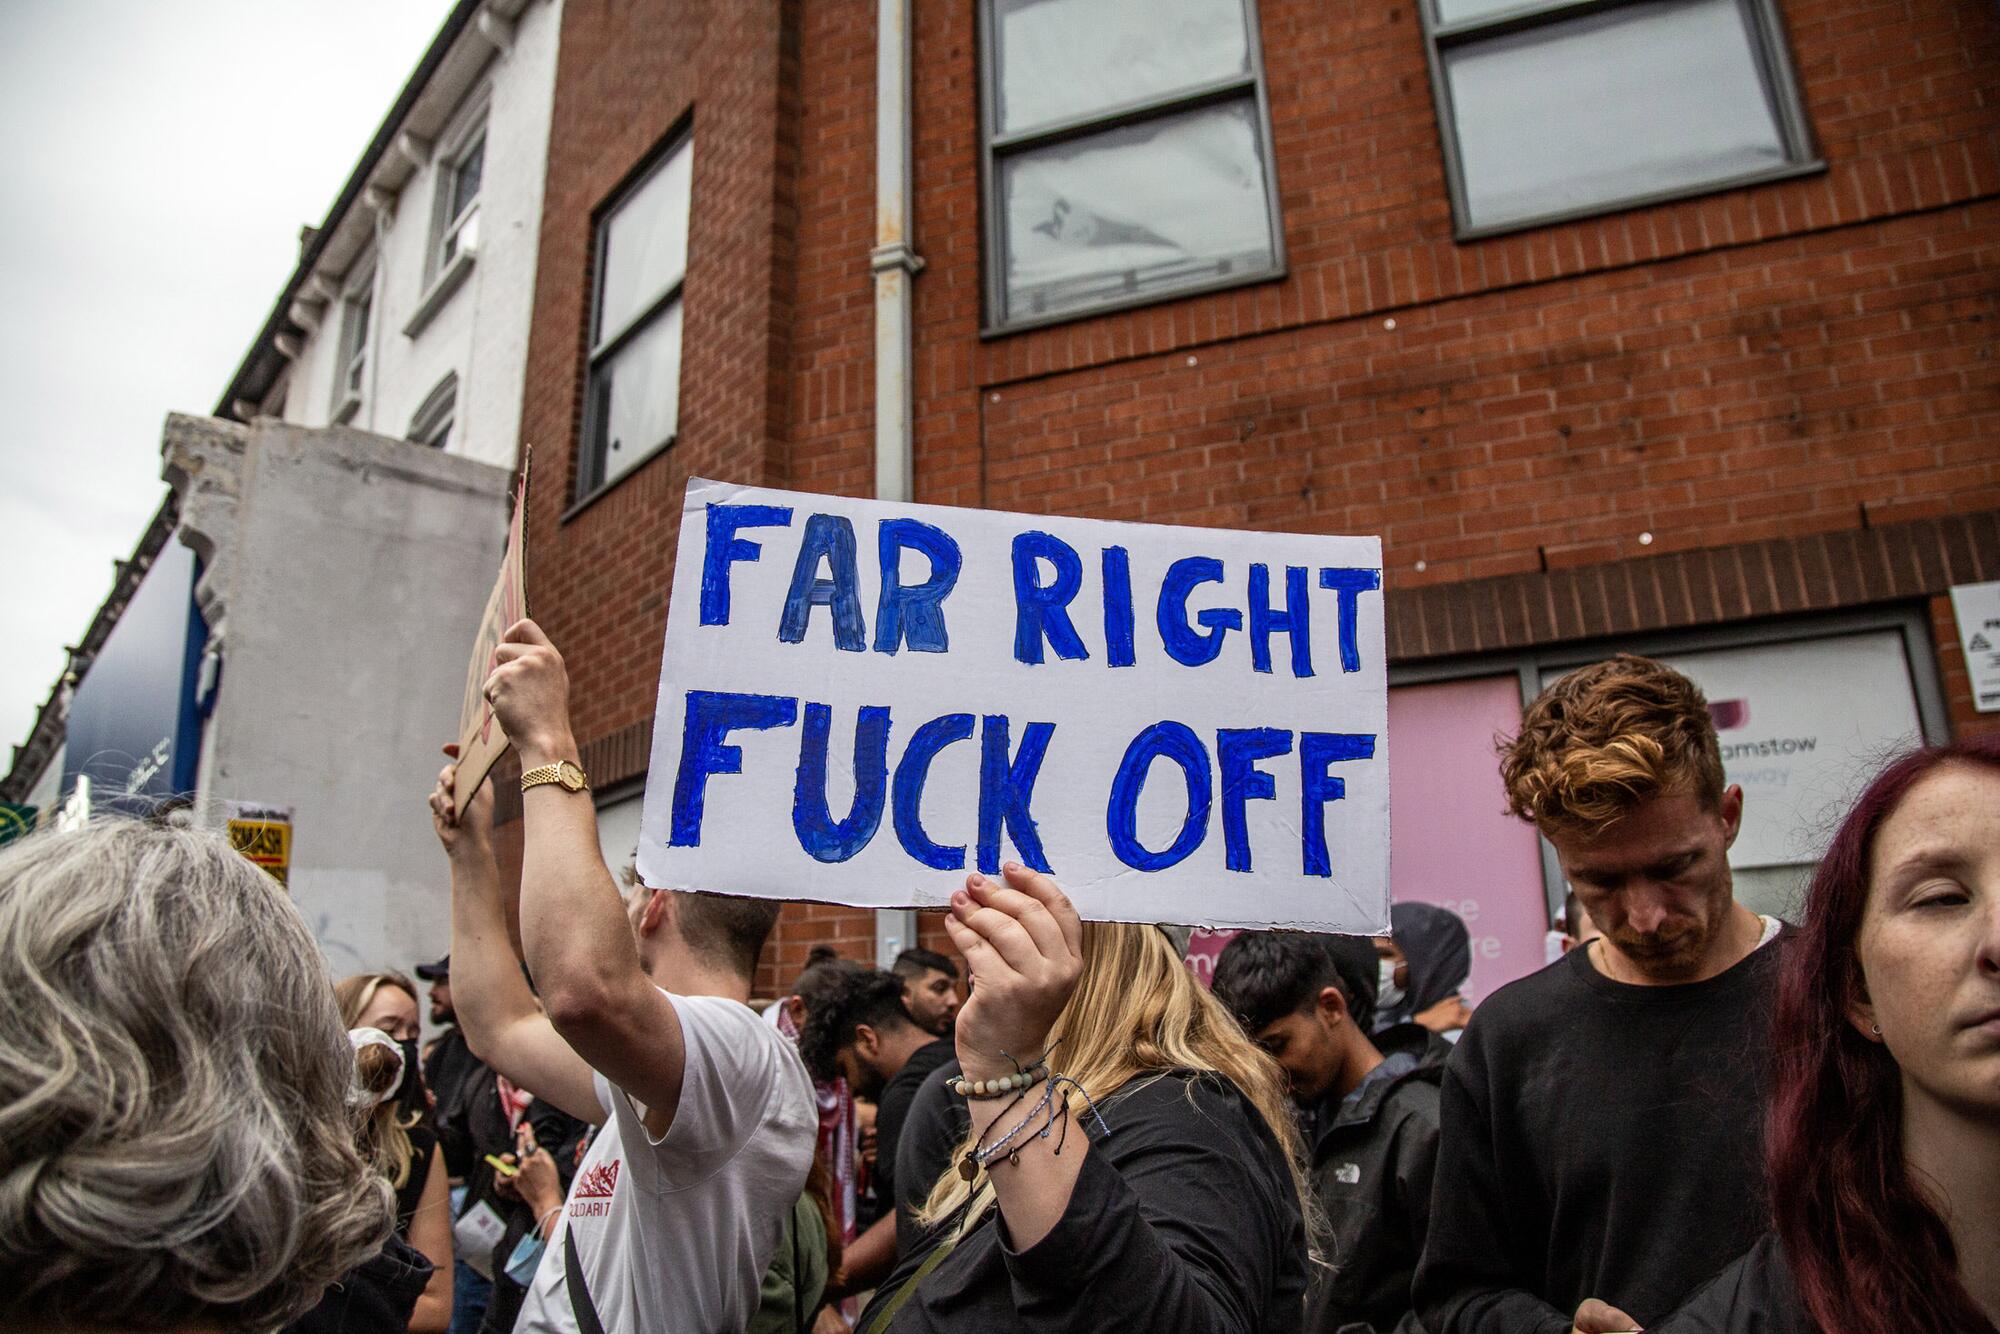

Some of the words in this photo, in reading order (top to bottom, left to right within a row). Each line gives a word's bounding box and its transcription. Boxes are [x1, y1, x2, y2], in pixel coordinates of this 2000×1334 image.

[699, 502, 962, 656] FAR
[1011, 530, 1381, 678] RIGHT
[667, 690, 1056, 876] FUCK
[1107, 720, 1377, 877] OFF
[1721, 736, 1818, 760] amstow
